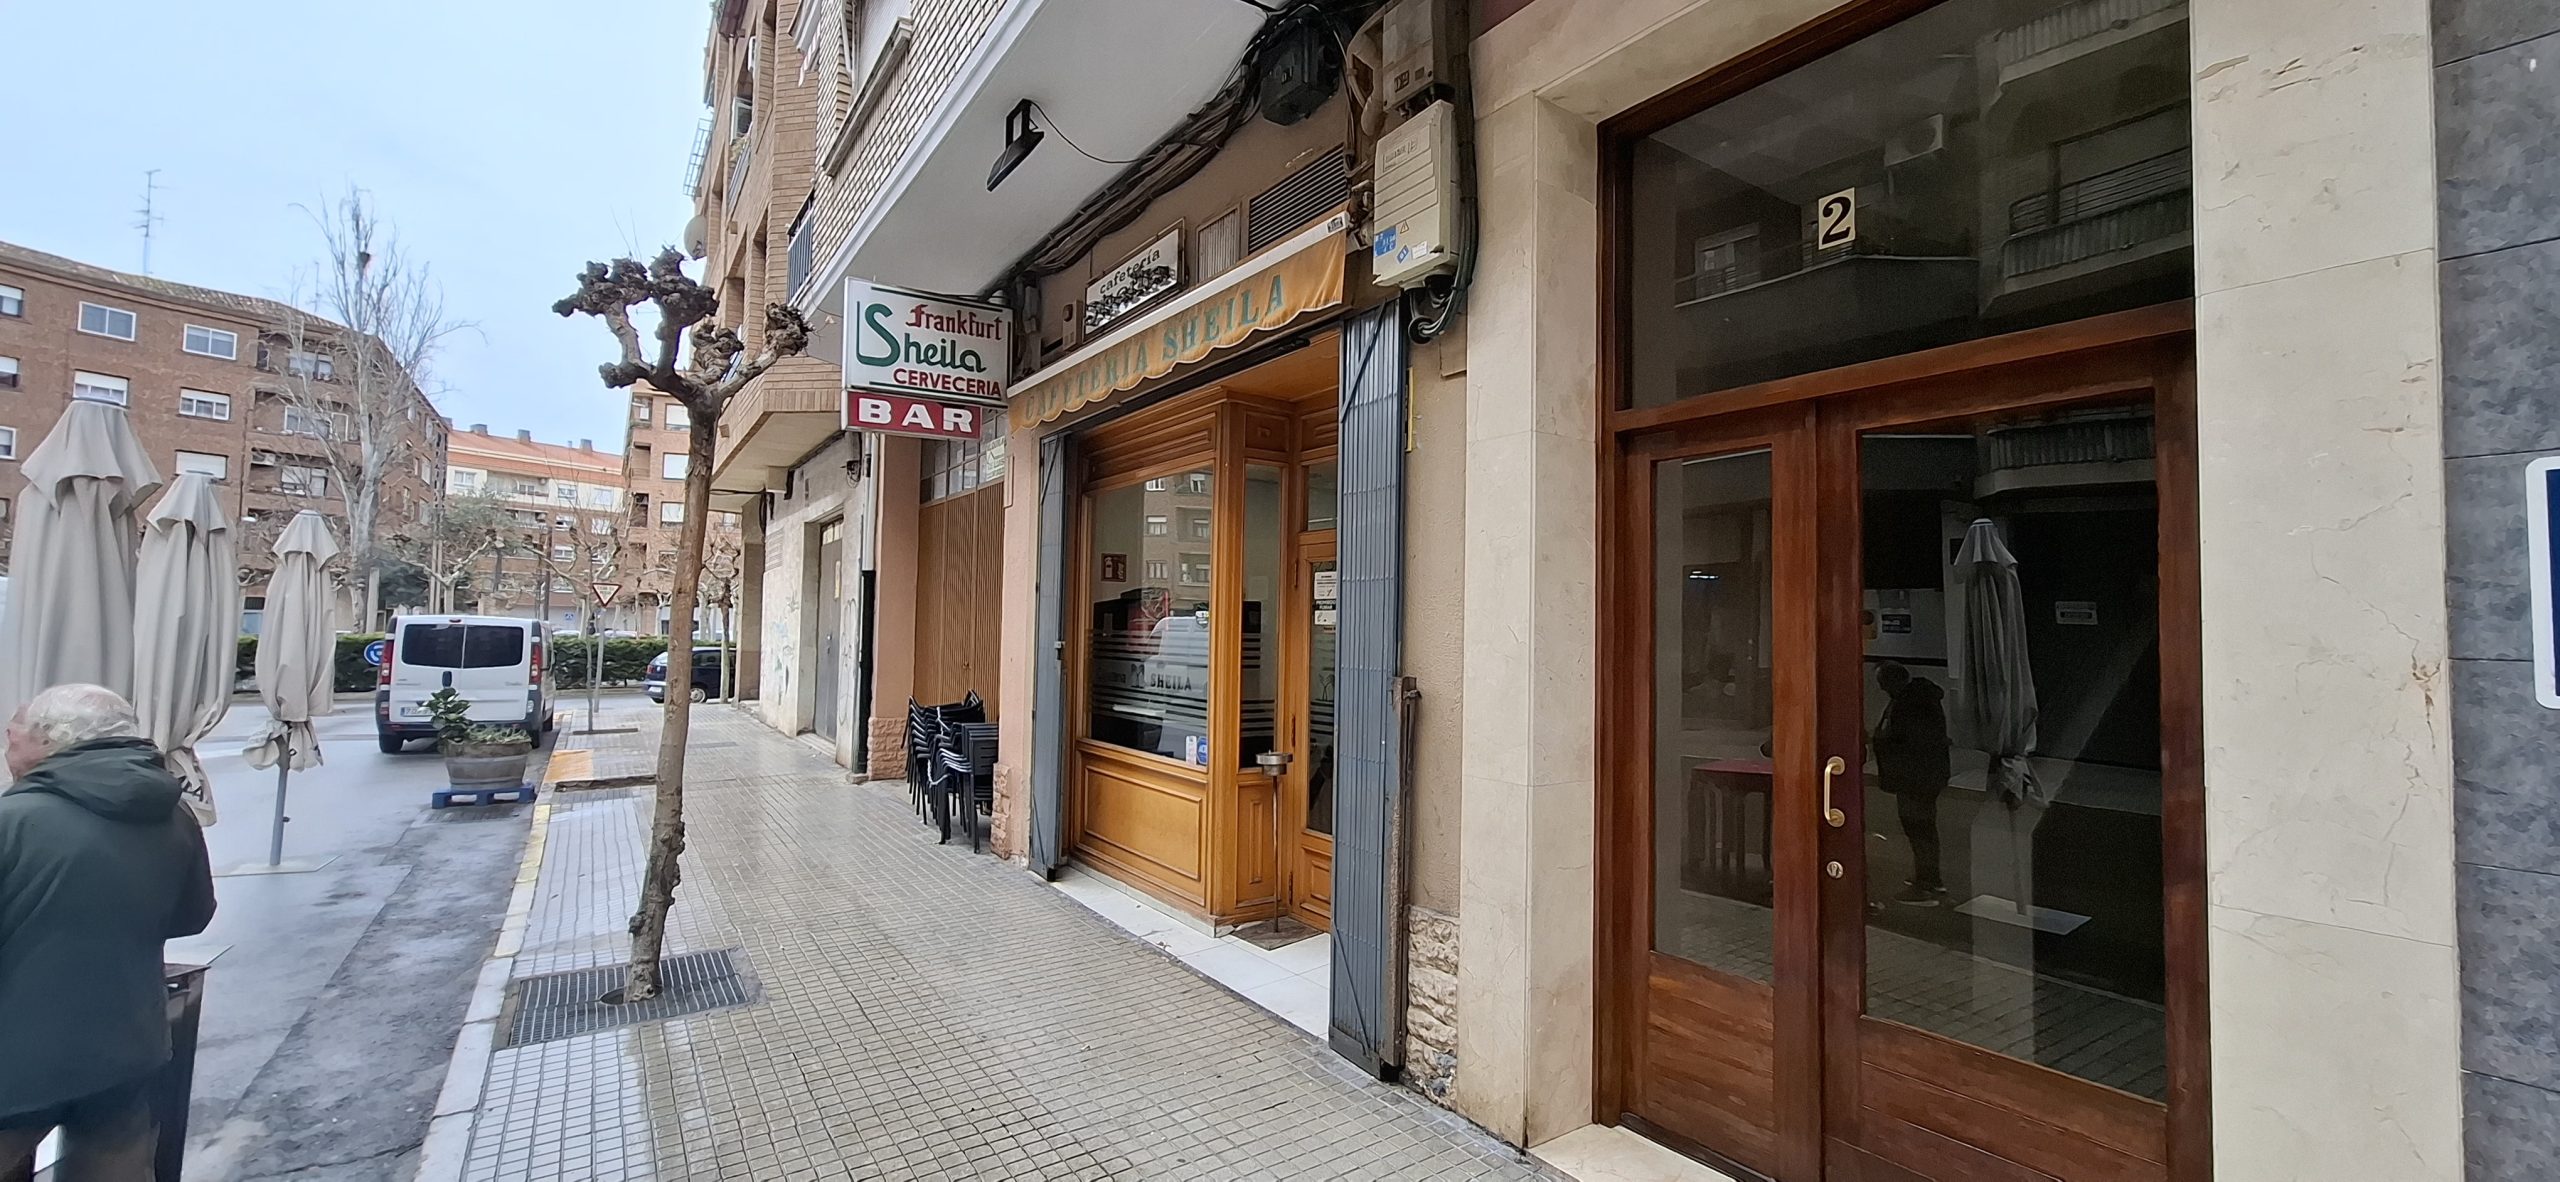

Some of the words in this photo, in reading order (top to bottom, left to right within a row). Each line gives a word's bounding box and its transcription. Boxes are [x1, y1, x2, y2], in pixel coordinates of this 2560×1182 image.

[1822, 196, 1852, 246] 2
[855, 300, 988, 374] Sheila
[1161, 273, 1286, 361] SHEILA
[892, 367, 1003, 398] CERVECERIA
[857, 397, 974, 434] BAR
[1150, 672, 1193, 692] SHEILA
